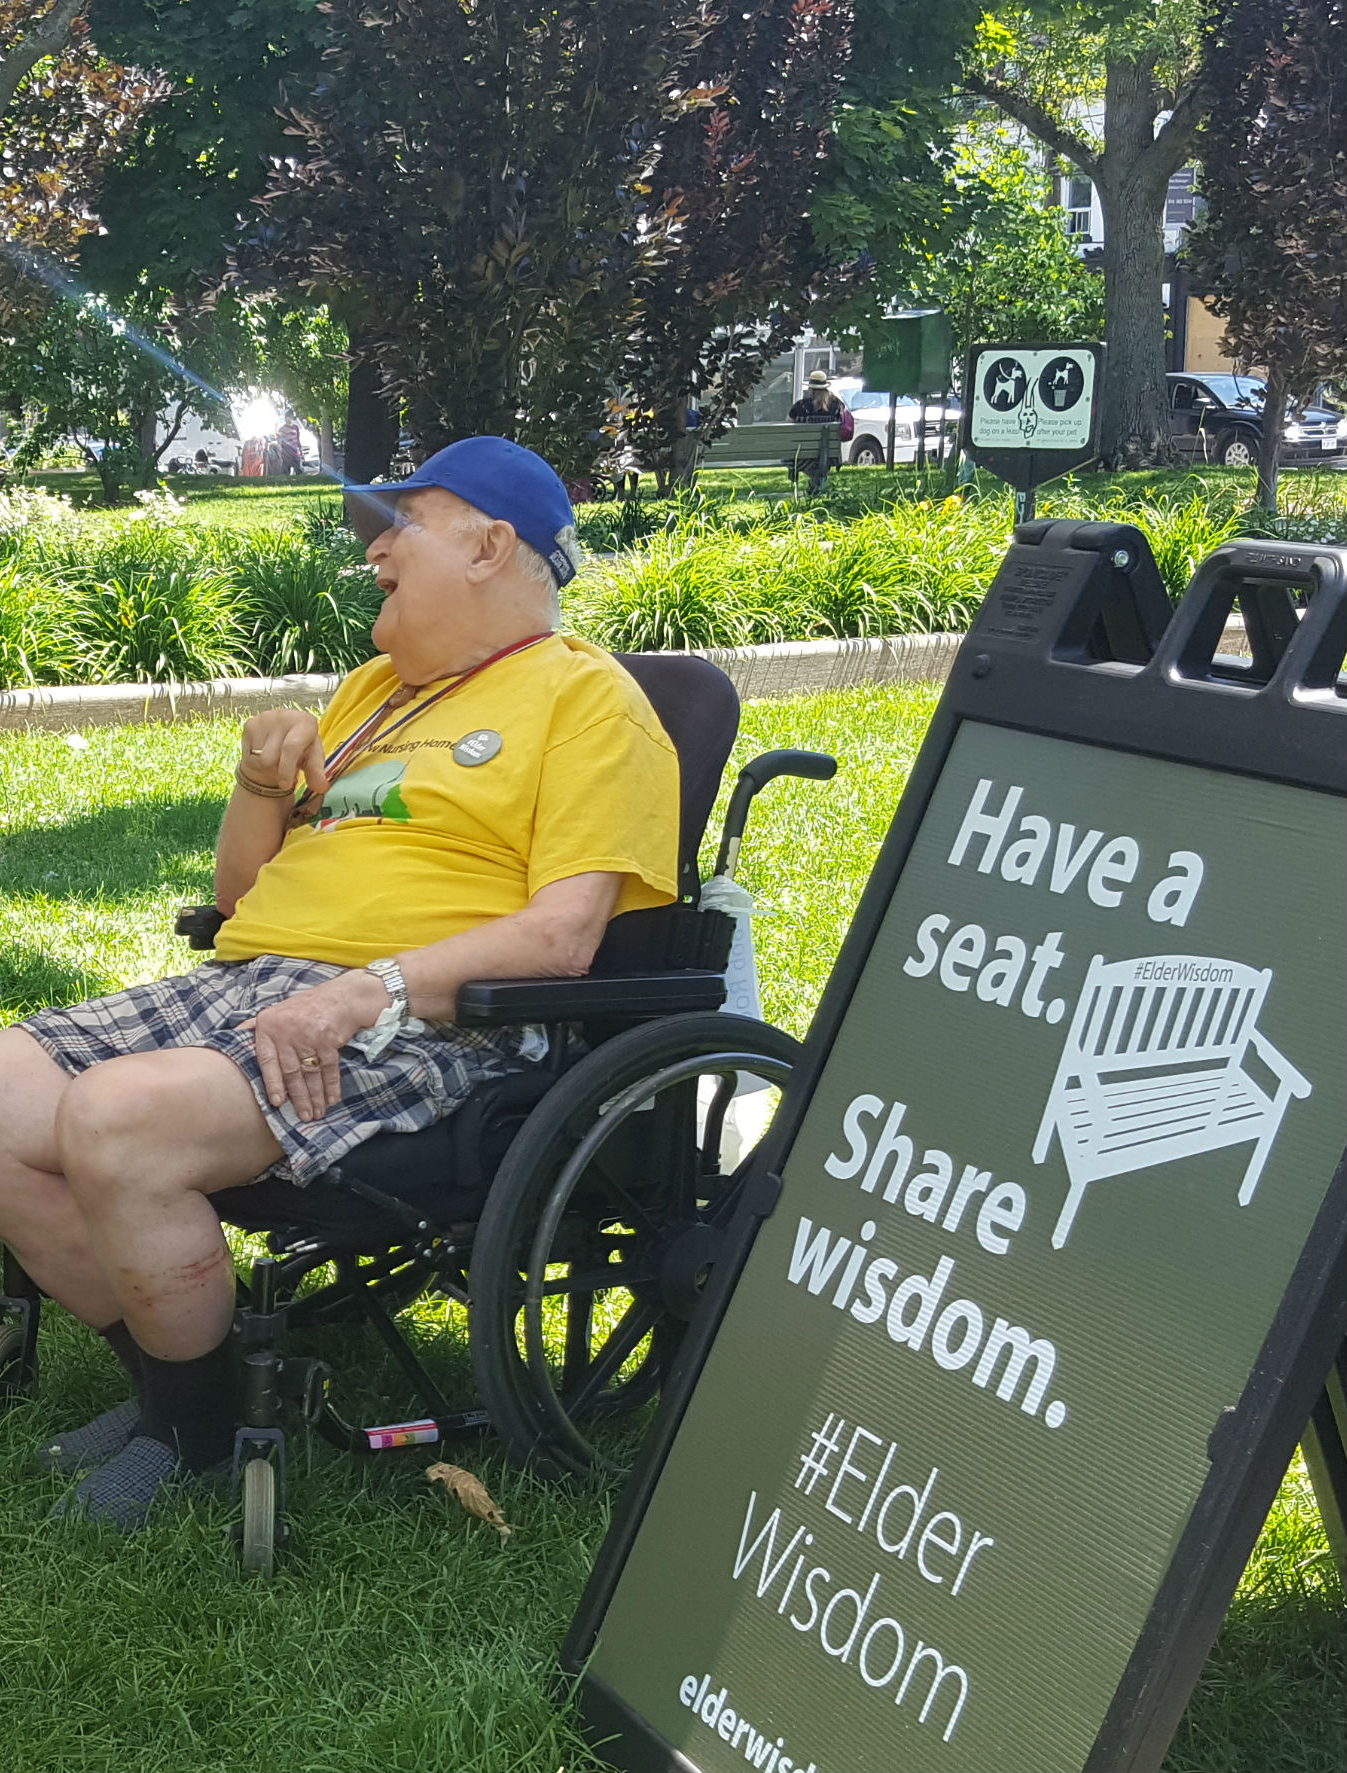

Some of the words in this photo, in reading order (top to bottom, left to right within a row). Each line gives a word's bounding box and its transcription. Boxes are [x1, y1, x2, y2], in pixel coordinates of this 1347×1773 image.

[1001, 417, 1016, 425] have
[1036, 427, 1051, 435] after
[1052, 429, 1065, 437] your
[1038, 417, 1058, 425] Please
[1059, 417, 1072, 427] pick
[378, 741, 419, 754] Nursing
[947, 778, 1140, 908] Have
[1146, 850, 1205, 928] a
[902, 912, 1066, 1025] seat.
[1133, 960, 1234, 984] #ElderWisdom
[823, 1092, 1027, 1256] Share
[787, 1215, 1068, 1430] wisdom.
[794, 1412, 995, 1597] #Elder
[732, 1489, 970, 1743] Wisdom
[679, 1673, 817, 1773] elderwis
